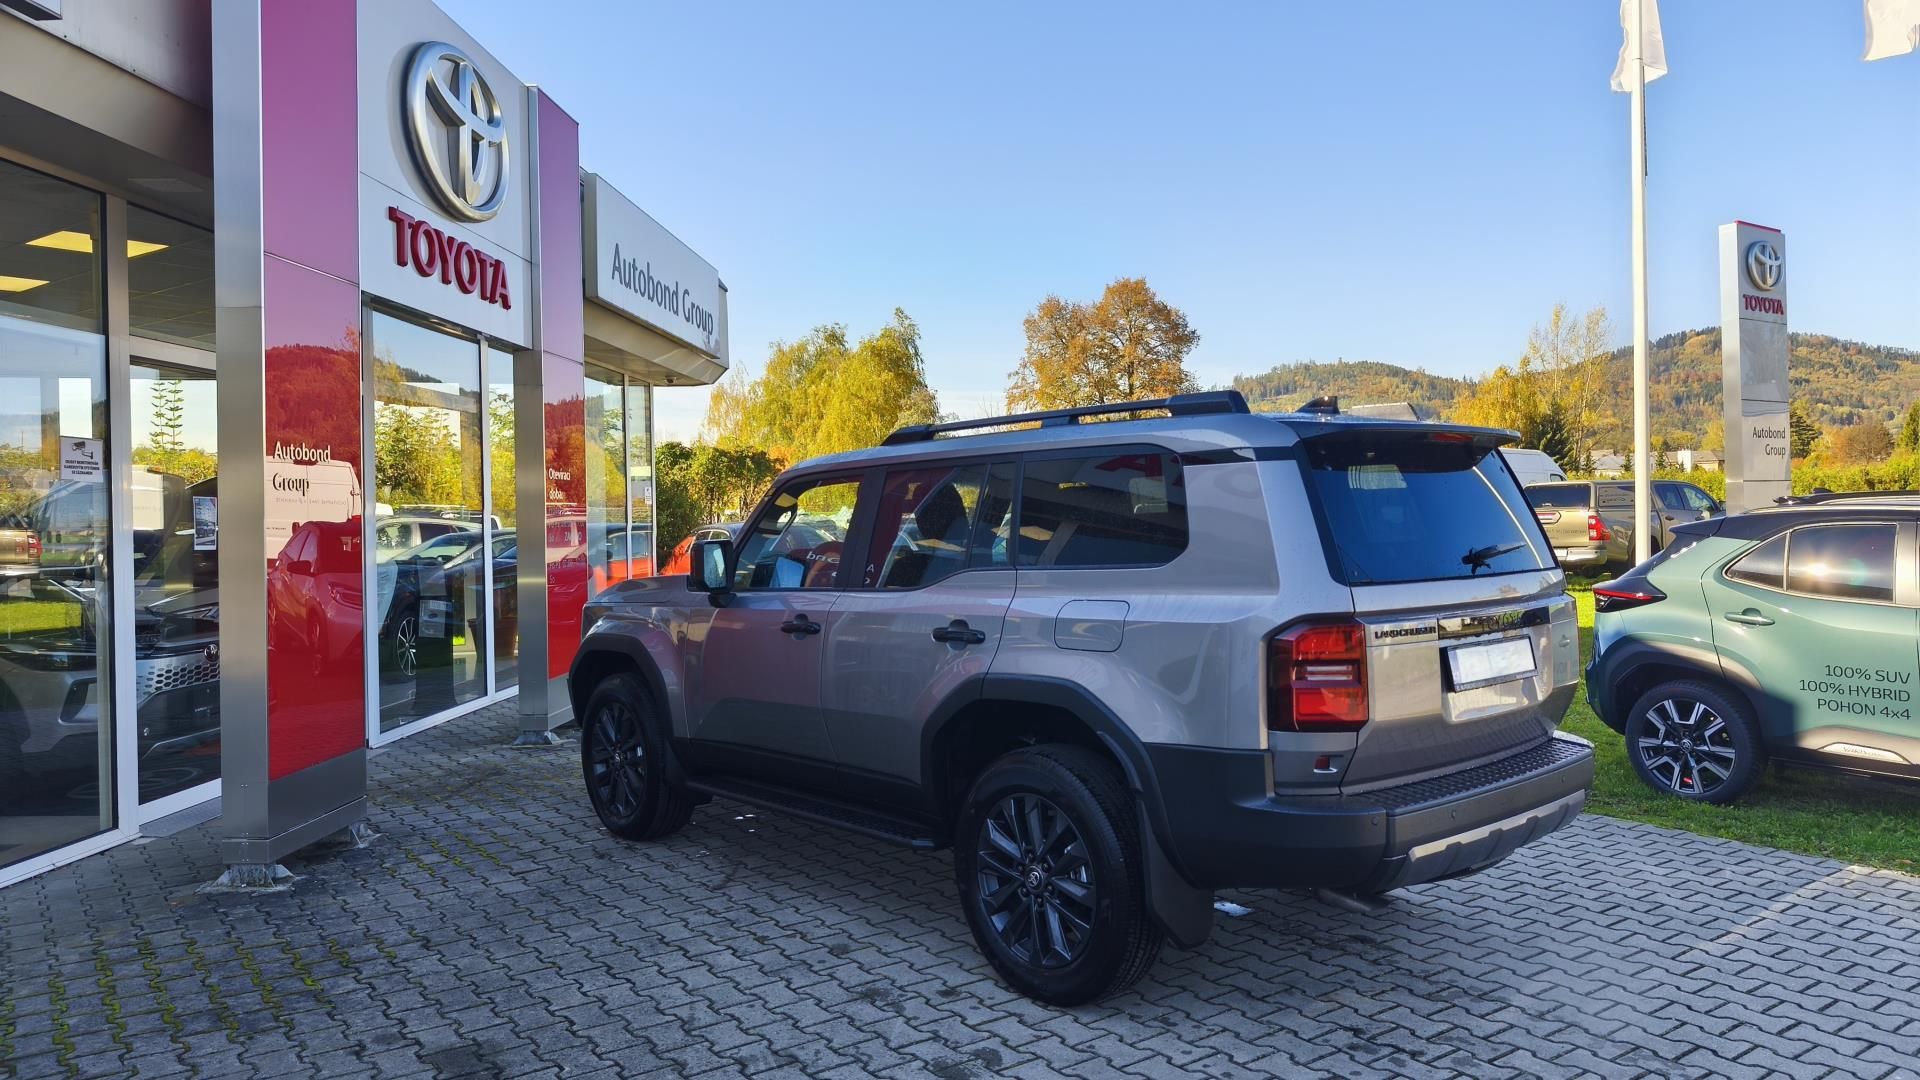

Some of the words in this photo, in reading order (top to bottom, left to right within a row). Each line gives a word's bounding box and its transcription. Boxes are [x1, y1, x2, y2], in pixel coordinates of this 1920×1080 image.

[388, 206, 511, 310] TOYOTA
[611, 242, 679, 317] Autobond
[682, 289, 714, 344] Group
[1743, 294, 1784, 315] TOYOTA
[1752, 426, 1786, 439] Autobond
[273, 441, 331, 462] Autobond
[1765, 444, 1786, 459] Group
[272, 473, 310, 496] Group
[1824, 664, 1872, 681] 100%
[1875, 669, 1911, 685] SUV
[1799, 679, 1845, 696] 100%
[1848, 684, 1911, 702] HYBRID
[1818, 698, 1876, 716] POHON
[1879, 706, 1912, 720] 4x4
